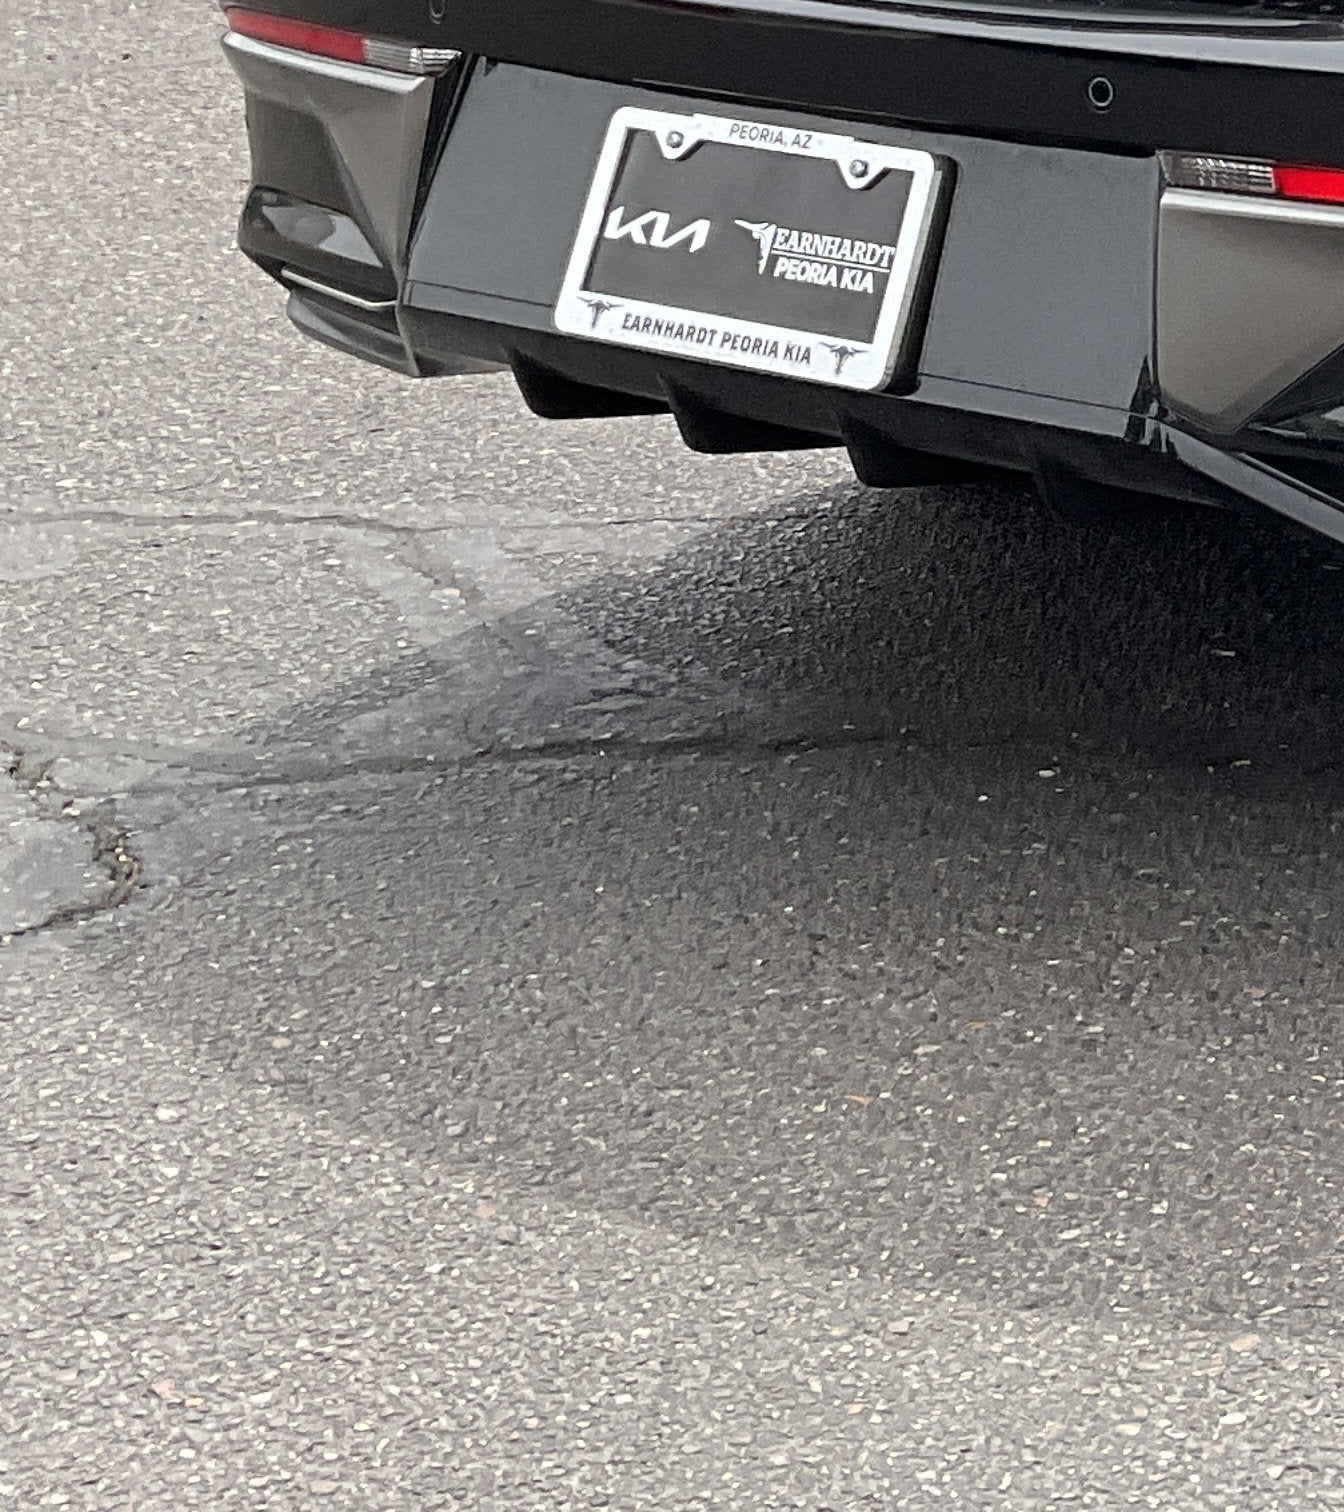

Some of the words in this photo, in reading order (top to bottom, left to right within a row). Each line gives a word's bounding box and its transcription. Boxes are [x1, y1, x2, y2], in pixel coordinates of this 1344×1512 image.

[728, 123, 788, 147] PEORIA,
[792, 133, 813, 150] AZ
[771, 227, 897, 269] EARNHARDT
[772, 258, 838, 288] PEORIA
[839, 267, 875, 295] KIA
[621, 312, 718, 347] EARNHARDT
[721, 331, 779, 359] PEORIA
[782, 343, 812, 365] KIA
